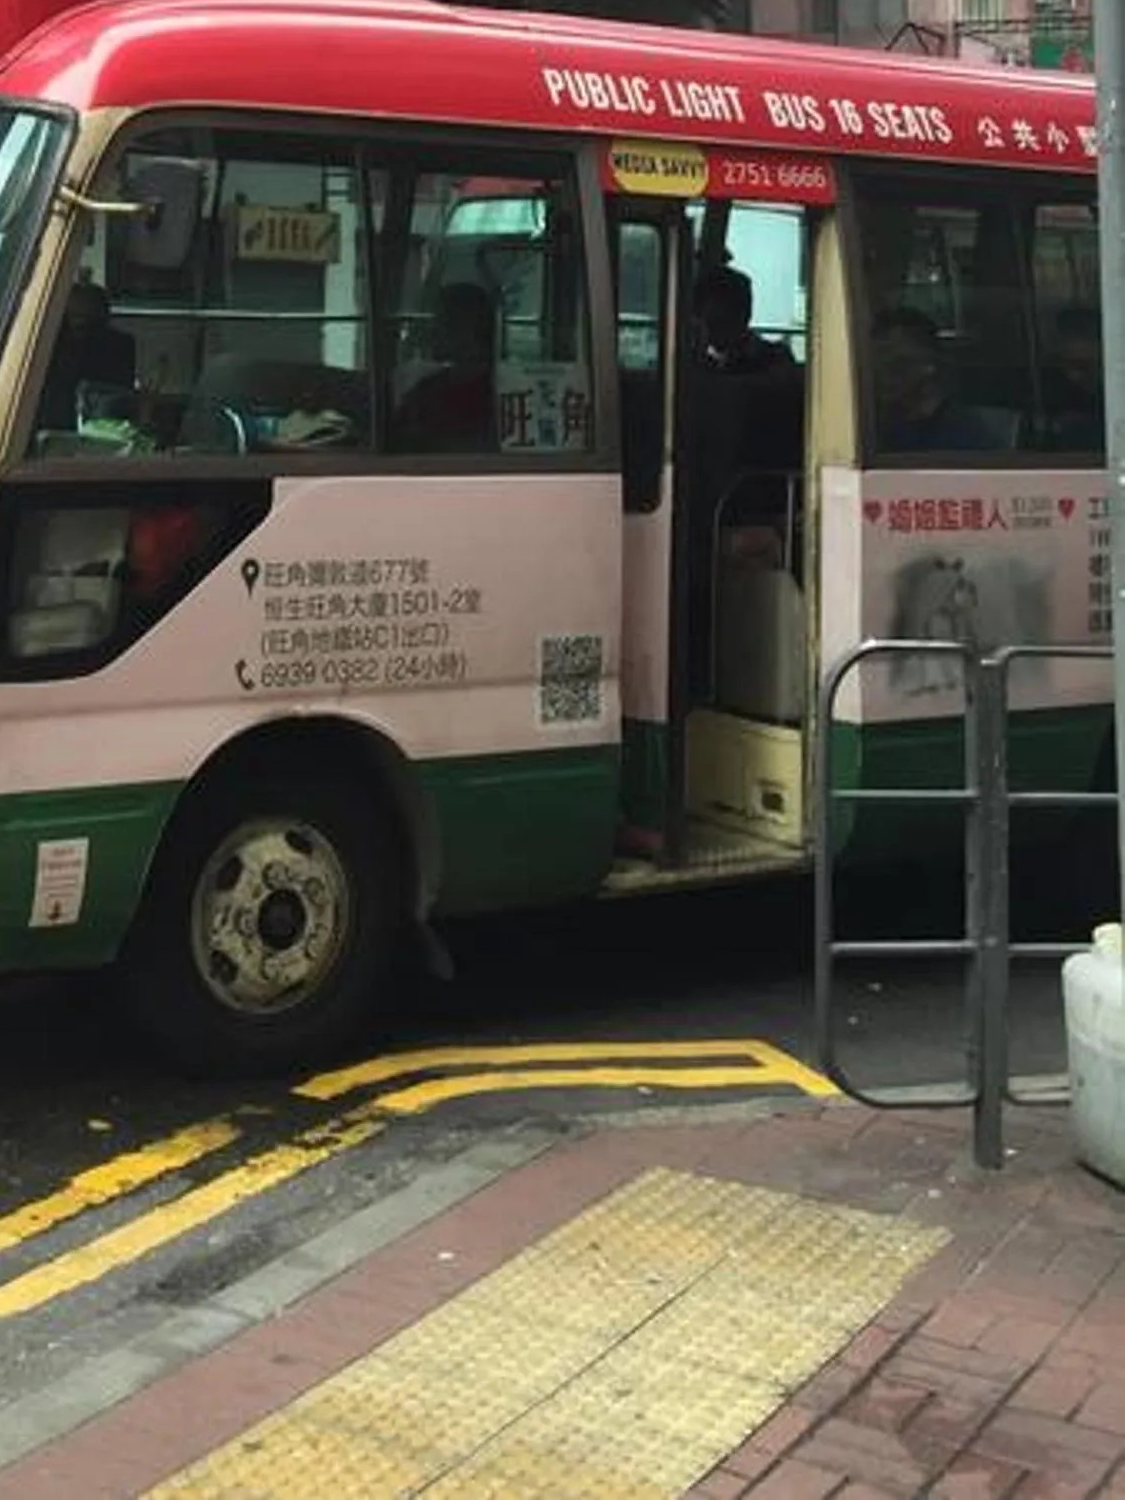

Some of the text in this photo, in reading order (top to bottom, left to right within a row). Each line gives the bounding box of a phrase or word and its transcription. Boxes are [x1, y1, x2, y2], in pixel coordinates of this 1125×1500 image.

[542, 68, 656, 116] PUBLIC
[660, 78, 745, 124] LIGHT
[762, 91, 826, 134] BUS
[829, 99, 863, 136] 16
[868, 102, 954, 145] SEATS
[723, 159, 771, 187] 2751
